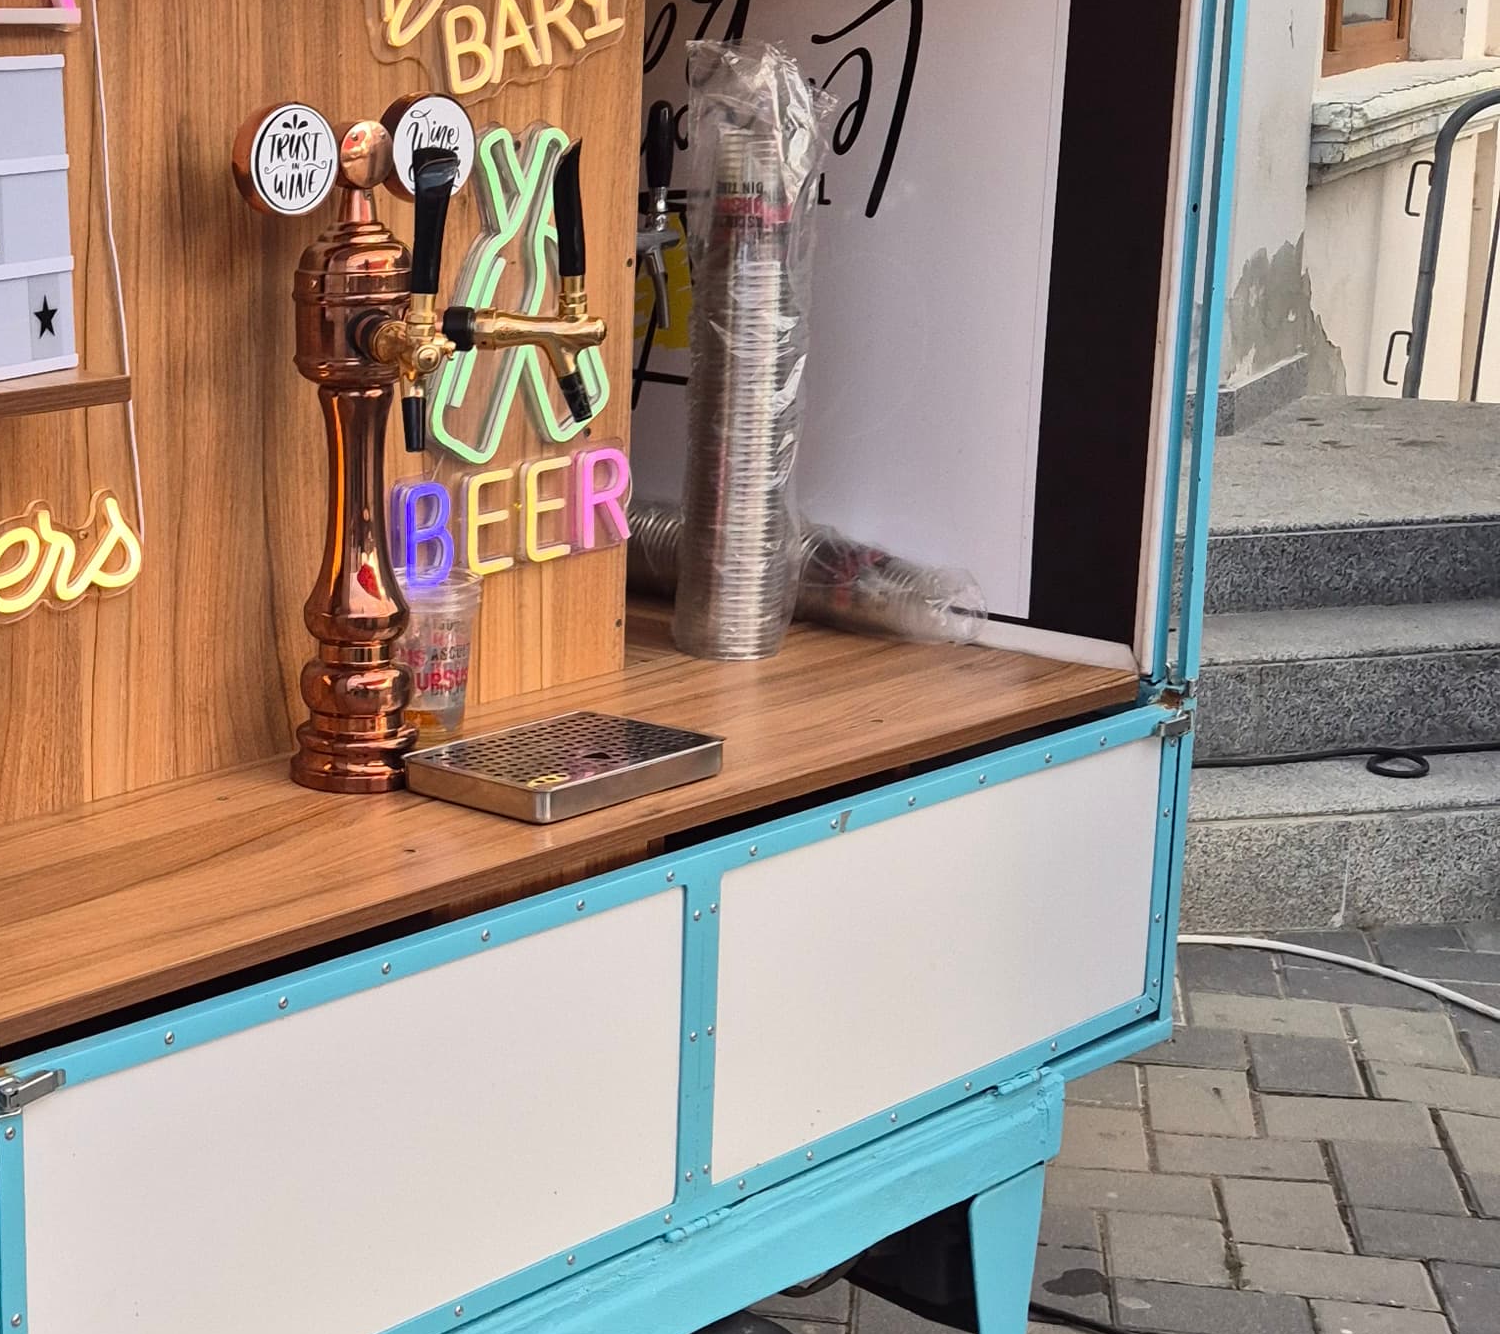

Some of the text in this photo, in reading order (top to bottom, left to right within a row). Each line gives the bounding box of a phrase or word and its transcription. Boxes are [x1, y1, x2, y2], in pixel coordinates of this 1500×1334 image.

[267, 131, 323, 163] TRUST
[273, 169, 318, 201] WINE
[405, 448, 631, 587] BEER
